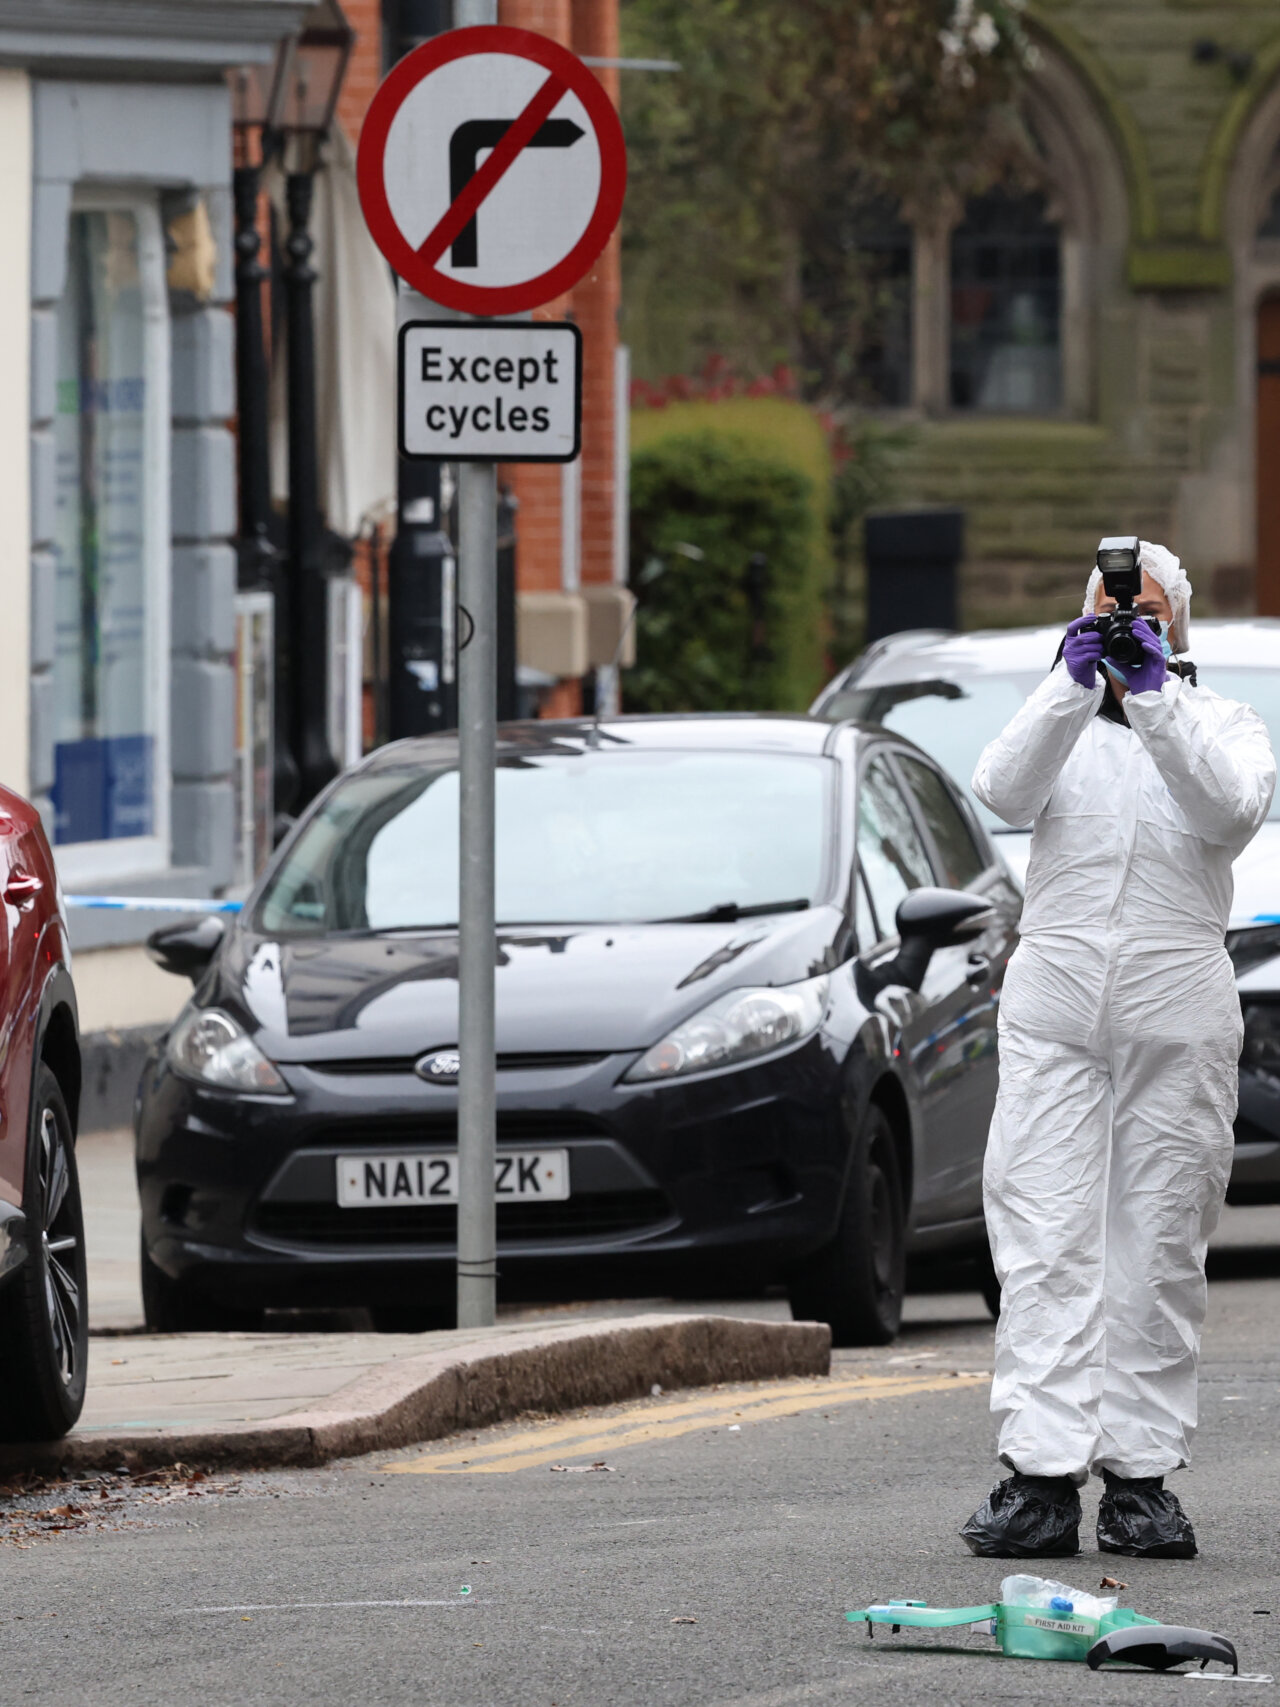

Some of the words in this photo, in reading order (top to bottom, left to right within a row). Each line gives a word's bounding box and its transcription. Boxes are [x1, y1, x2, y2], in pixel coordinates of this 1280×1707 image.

[421, 347, 559, 390] Except
[426, 396, 551, 438] cycles
[364, 1160, 451, 1198] NA12
[495, 1156, 541, 1193] ZK
[1034, 1618, 1056, 1629] FIRST
[1072, 1625, 1086, 1633] KIT
